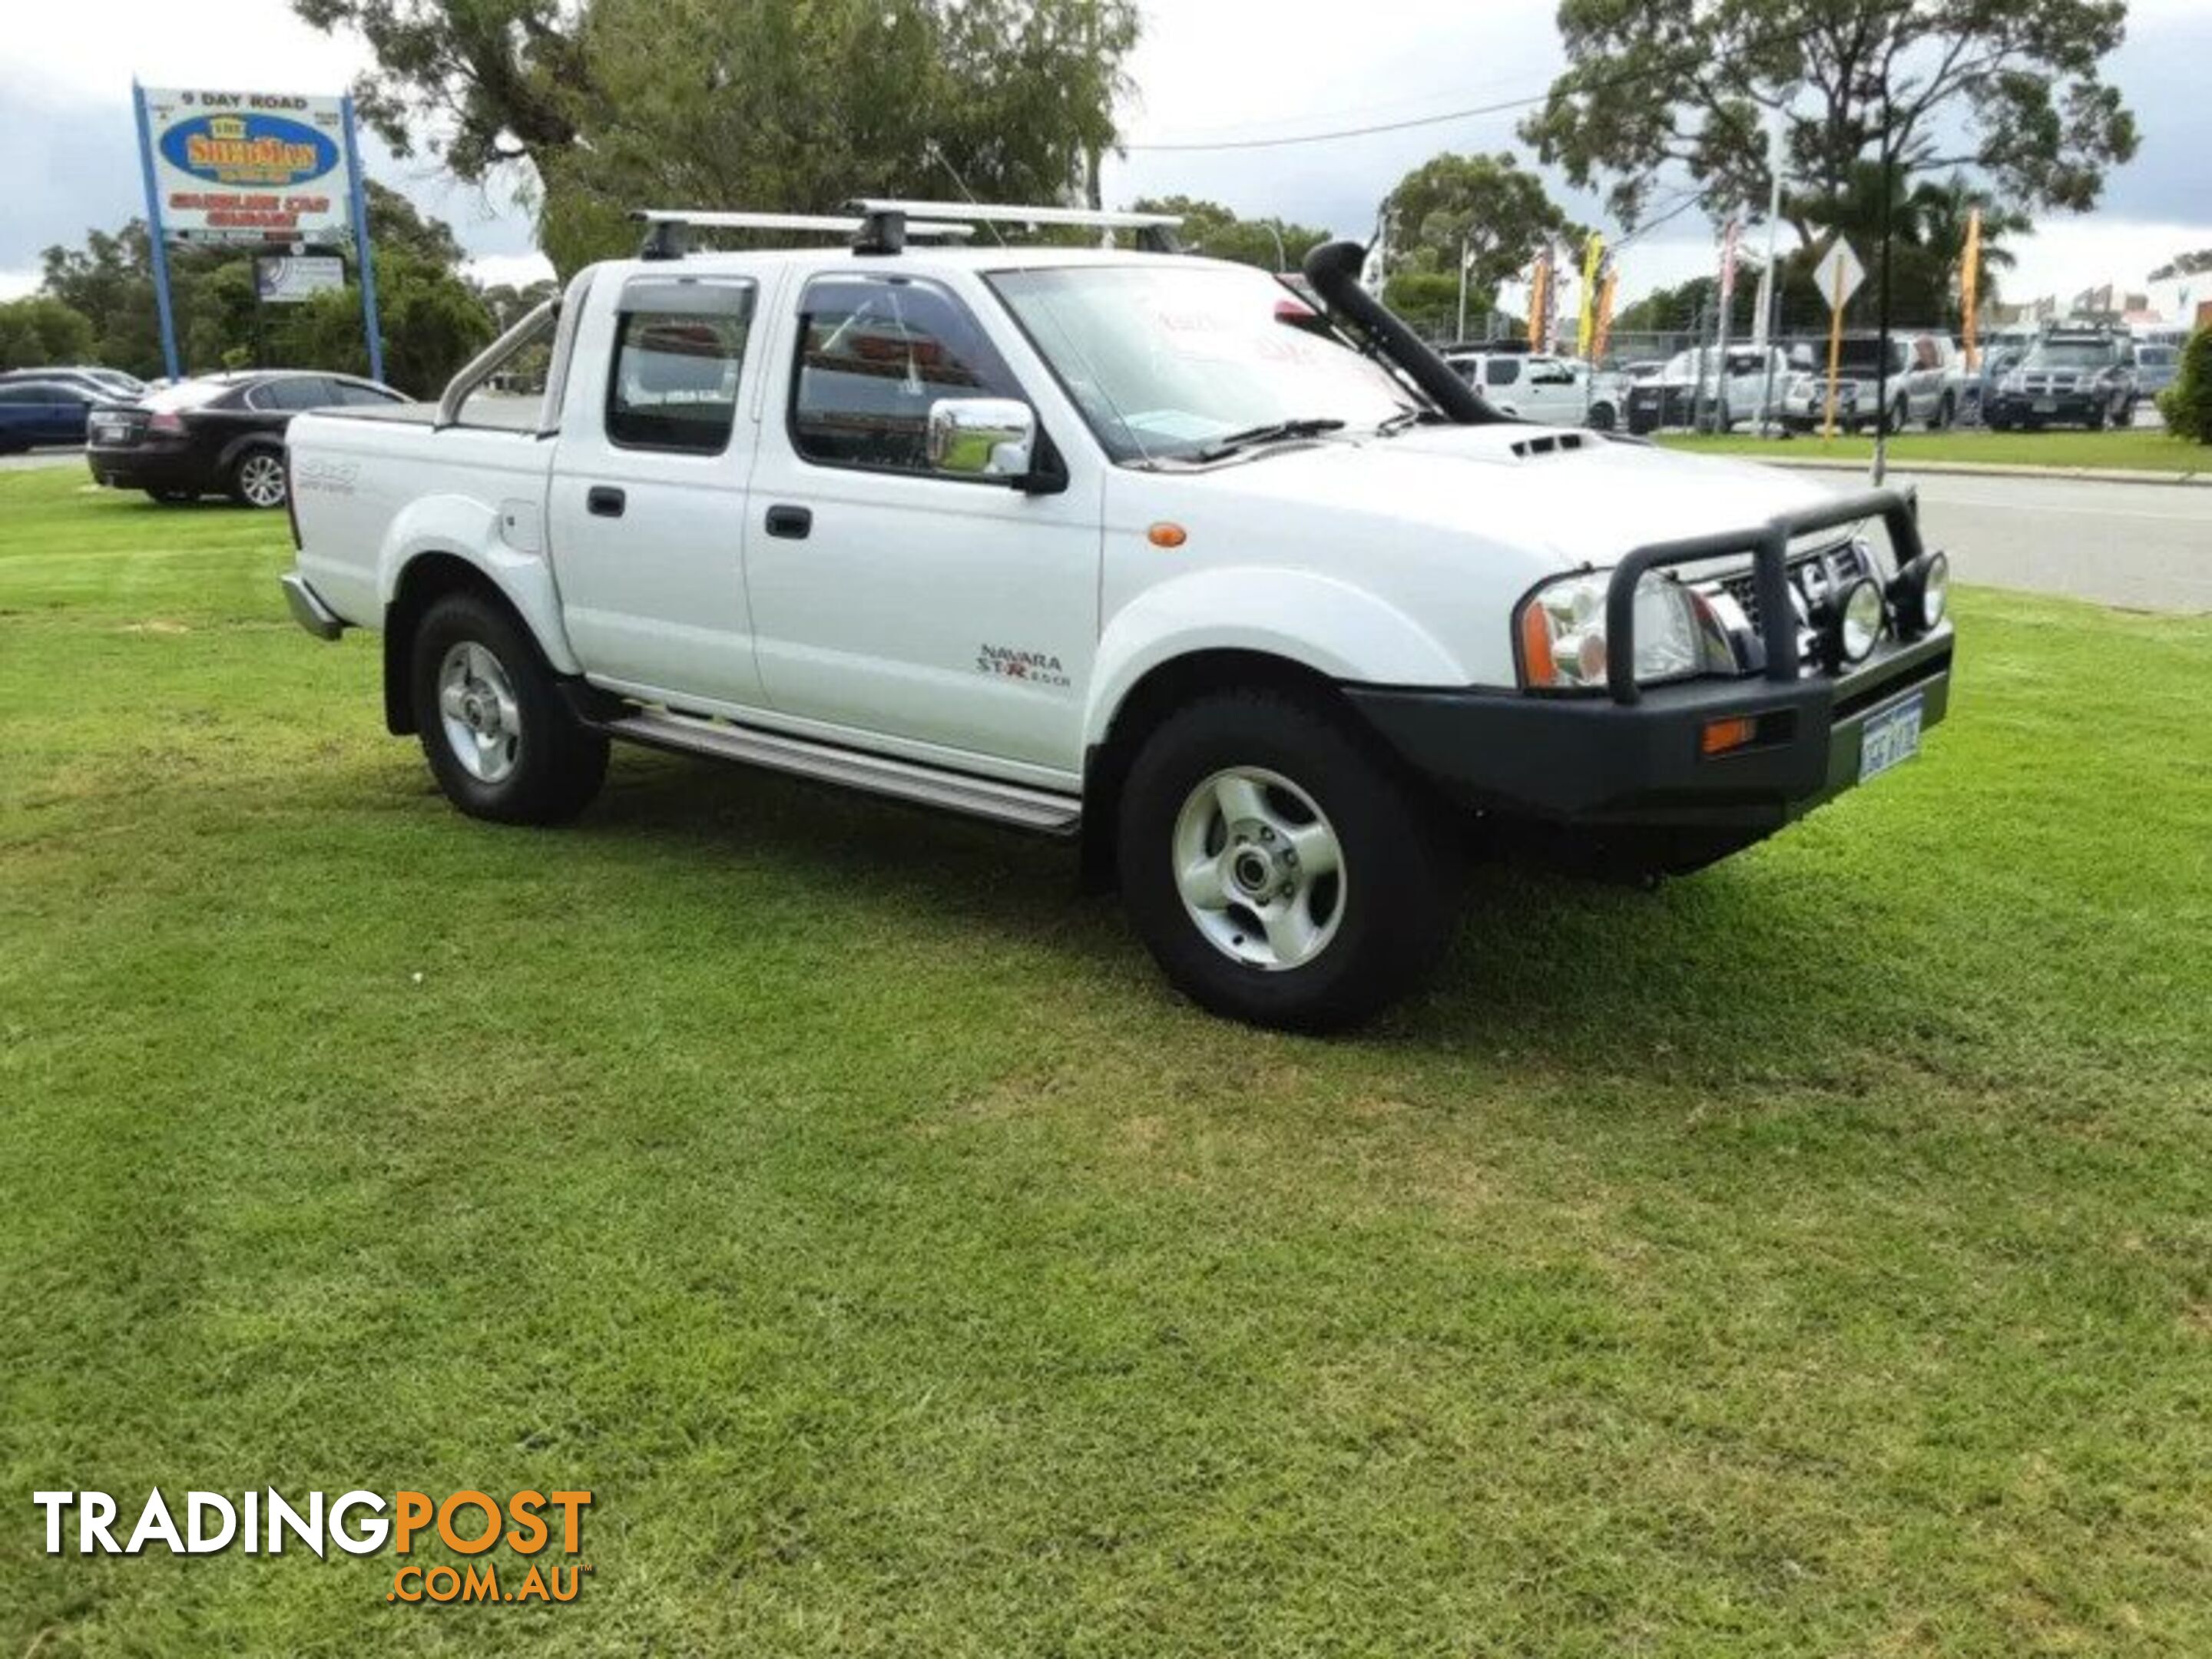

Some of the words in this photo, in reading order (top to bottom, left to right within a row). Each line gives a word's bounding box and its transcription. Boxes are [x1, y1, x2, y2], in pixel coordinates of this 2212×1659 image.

[181, 91, 194, 105] 9
[201, 93, 240, 107] DAY
[250, 94, 306, 110] ROAD
[981, 644, 1062, 672] NAVARA
